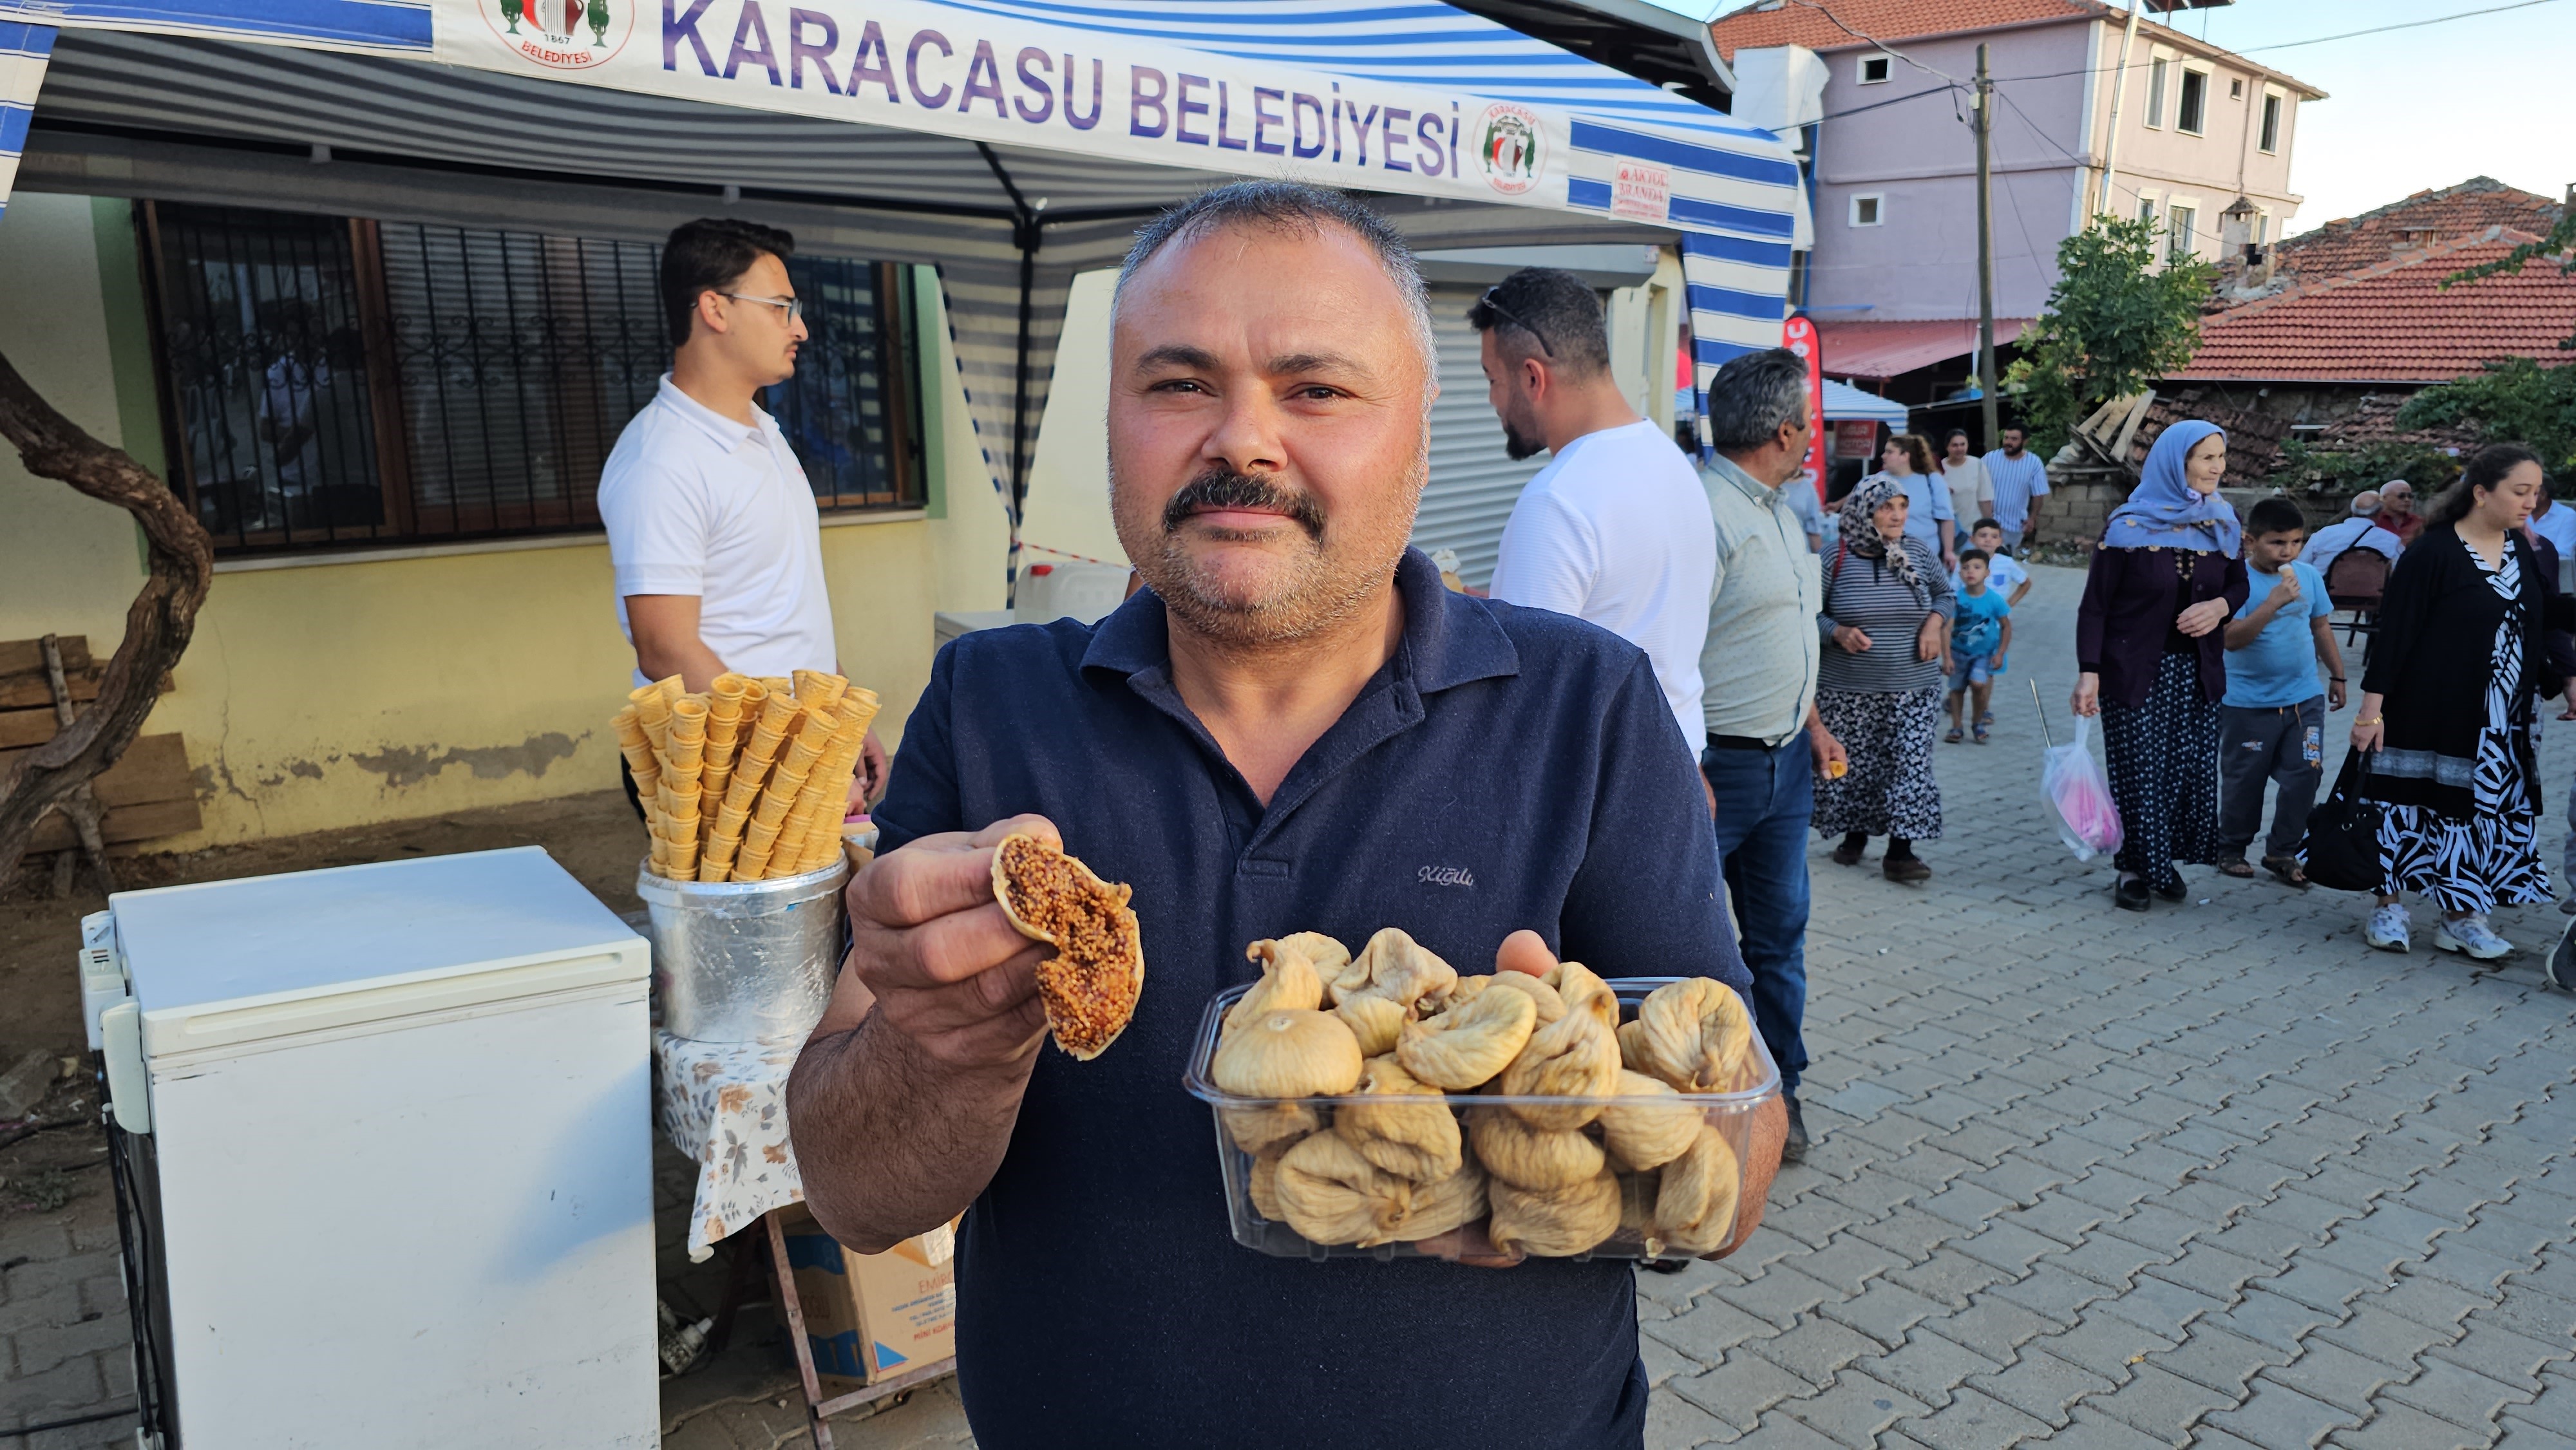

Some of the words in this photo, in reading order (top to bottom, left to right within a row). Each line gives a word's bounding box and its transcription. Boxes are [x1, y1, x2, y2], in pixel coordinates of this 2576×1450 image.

[522, 40, 594, 64] BELEDİYESİ
[663, 0, 1102, 130] KARACASU
[1130, 65, 1459, 179] BELEDİYESİ
